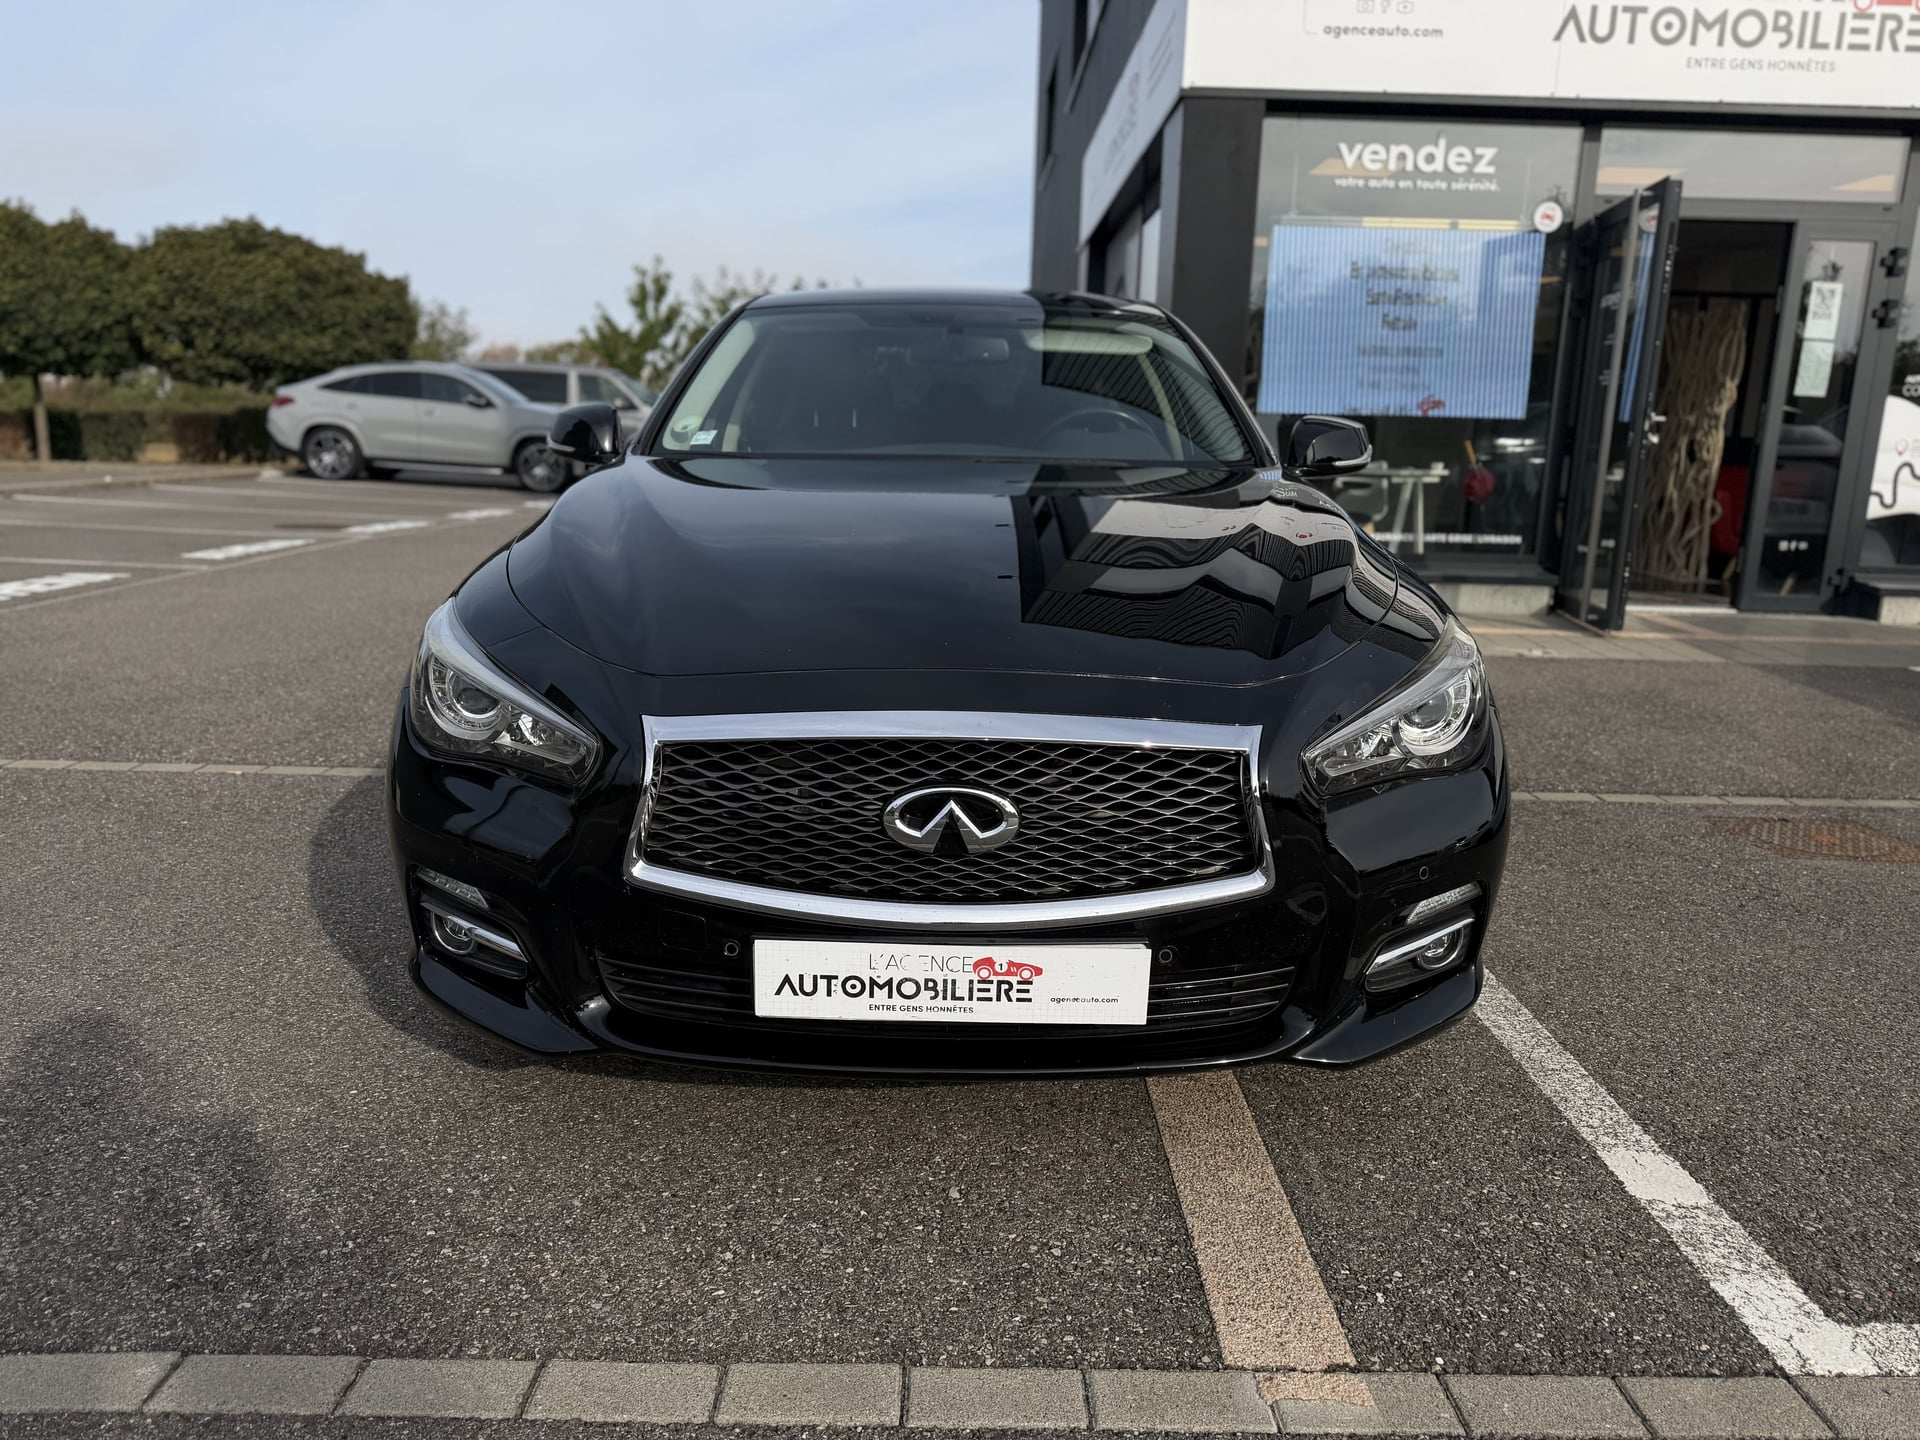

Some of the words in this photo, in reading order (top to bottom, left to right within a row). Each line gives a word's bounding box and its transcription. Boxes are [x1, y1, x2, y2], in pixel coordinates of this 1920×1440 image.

[1323, 25, 1444, 39] agenceauto.com
[1686, 57, 1726, 70] ENTRE
[1729, 58, 1764, 71] GENS
[1767, 57, 1836, 73] HONNÊTES
[1338, 137, 1498, 174] vendez
[1334, 177, 1365, 188] votre
[1368, 178, 1395, 189] auto
[1398, 180, 1414, 190] en
[1416, 179, 1448, 191] toute
[868, 1003, 897, 1012] ENTRE
[899, 1004, 924, 1013] GENS
[926, 1004, 974, 1014] HONNÊTES
